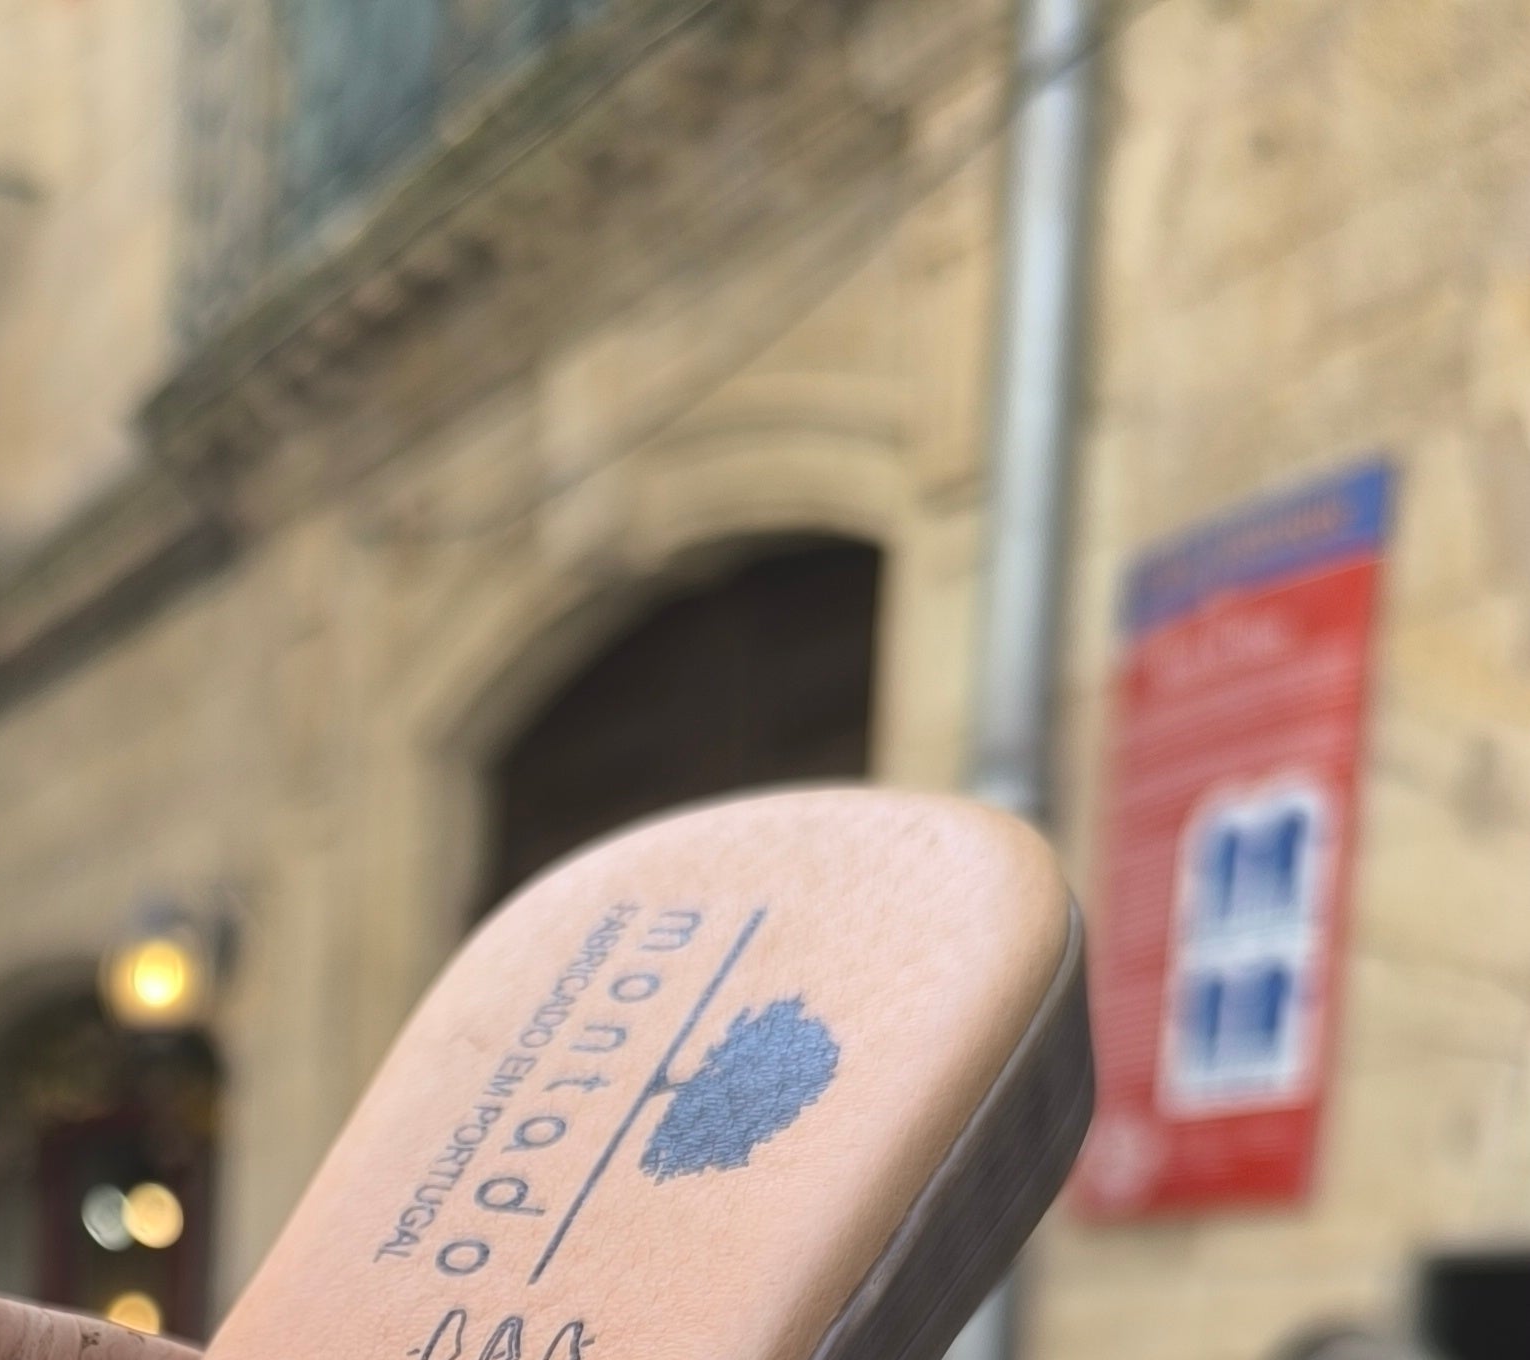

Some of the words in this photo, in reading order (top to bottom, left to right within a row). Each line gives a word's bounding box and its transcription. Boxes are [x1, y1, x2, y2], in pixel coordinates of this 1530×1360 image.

[519, 904, 643, 1049] FABRICADO
[435, 909, 702, 1277] montado
[483, 1056, 538, 1098] EM
[372, 1104, 505, 1264] PORTUGAL
